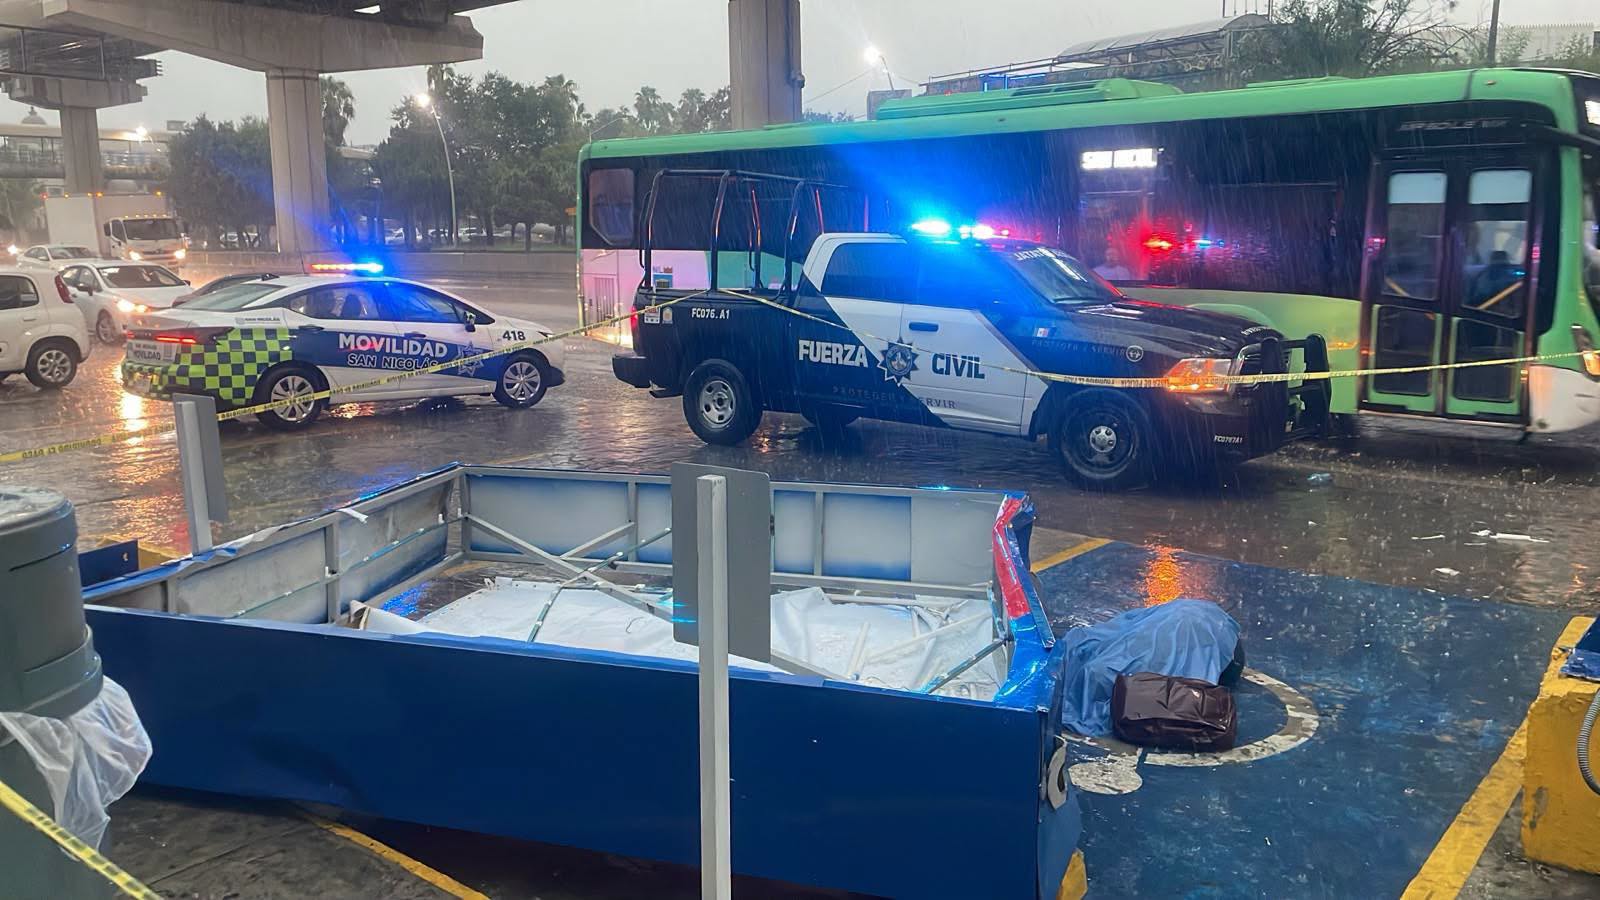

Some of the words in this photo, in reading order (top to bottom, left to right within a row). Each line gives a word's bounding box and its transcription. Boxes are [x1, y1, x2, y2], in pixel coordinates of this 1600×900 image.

[691, 308, 730, 319] FC076.A1
[502, 330, 526, 341] 418
[339, 333, 448, 358] MOVILIDAD
[347, 354, 377, 367] SAN
[382, 356, 438, 371] NICOLÁS
[798, 340, 868, 368] FUERZA
[931, 352, 985, 379] CIVIL
